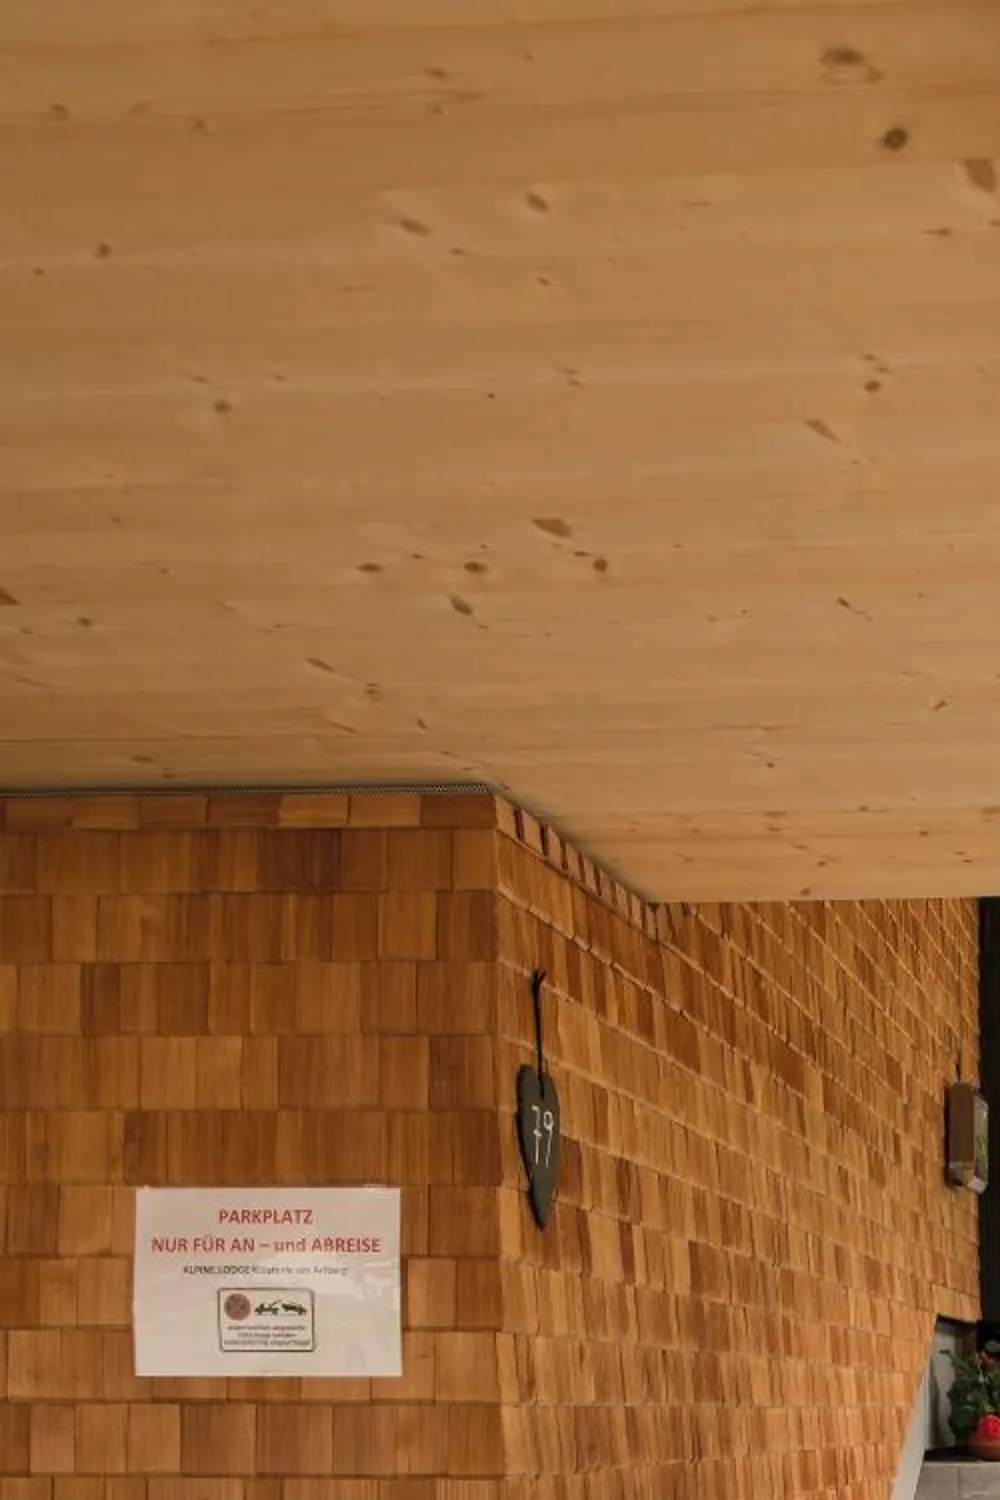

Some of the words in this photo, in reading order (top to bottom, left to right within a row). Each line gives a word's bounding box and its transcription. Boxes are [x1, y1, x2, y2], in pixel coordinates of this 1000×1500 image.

[531, 1104, 554, 1168] 19
[219, 1209, 313, 1225] PARKPLATZ
[151, 1237, 188, 1253] NUR
[193, 1234, 225, 1253] FÜR
[231, 1237, 255, 1253] AN
[274, 1238, 306, 1253] und
[311, 1237, 382, 1253] ABREISE
